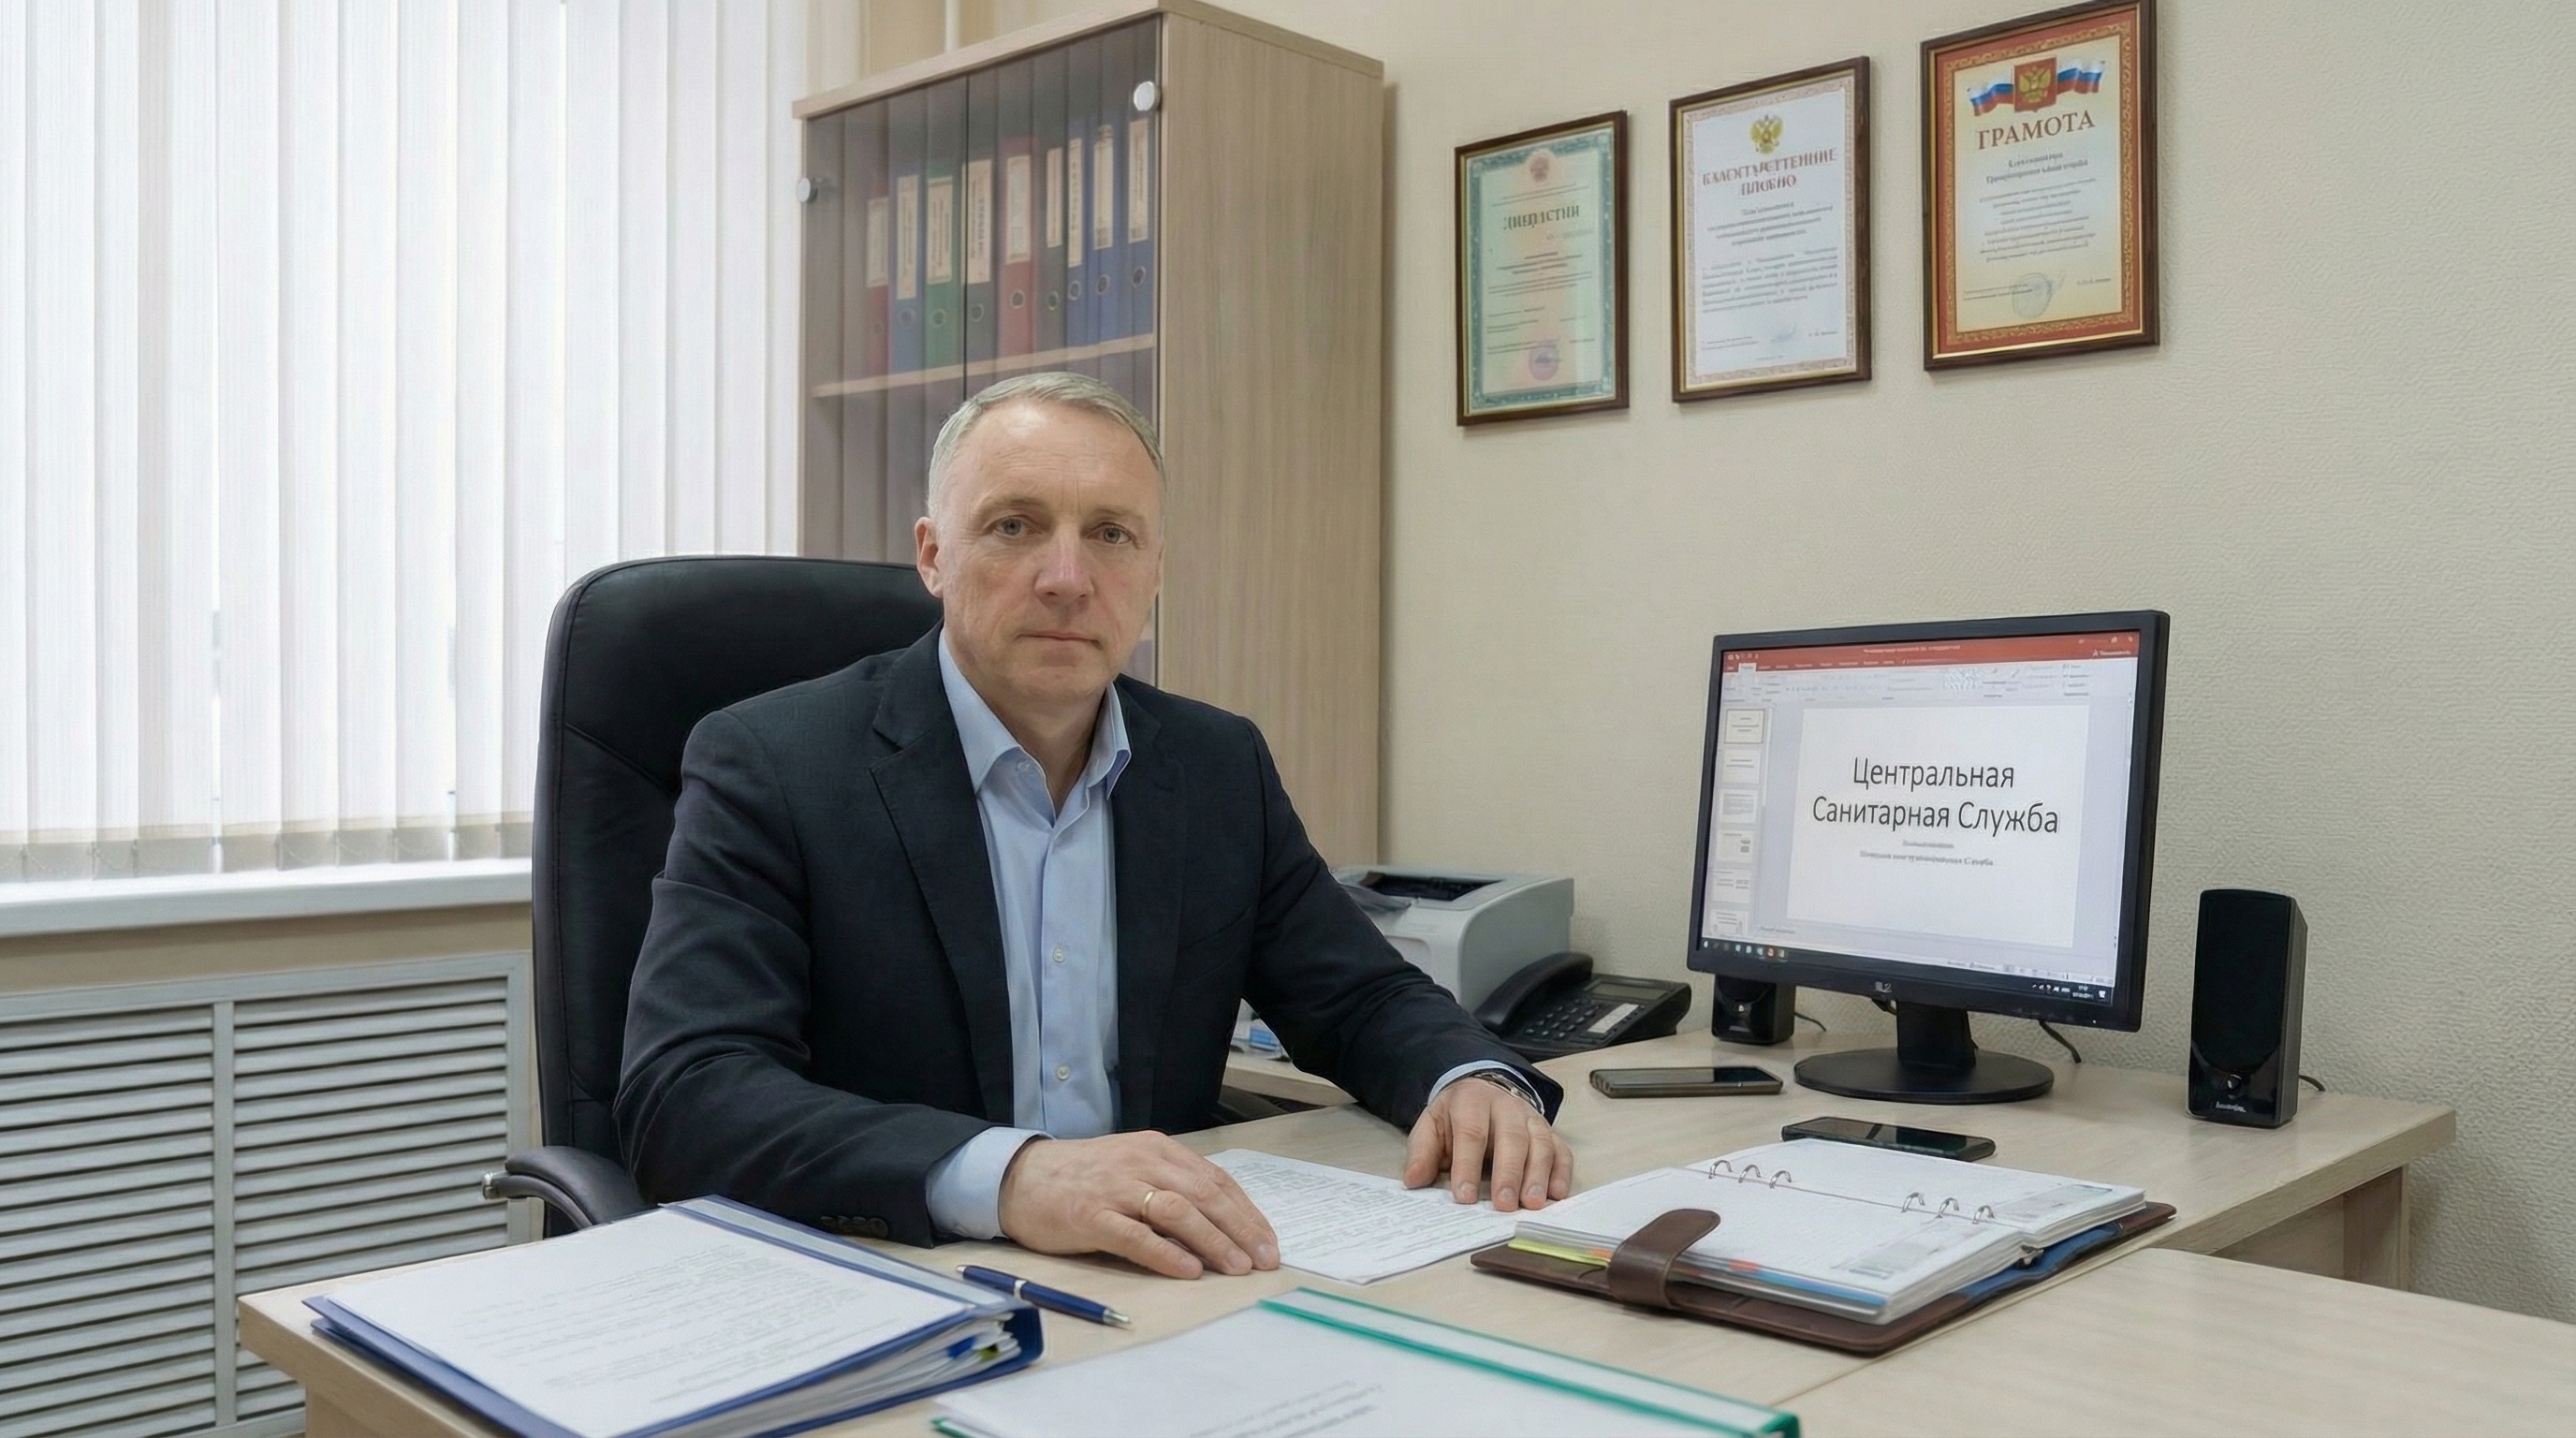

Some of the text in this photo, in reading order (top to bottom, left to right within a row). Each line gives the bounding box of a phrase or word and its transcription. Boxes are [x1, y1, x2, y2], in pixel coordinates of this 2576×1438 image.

[1977, 110, 2096, 150] ГРАМОТА
[1853, 756, 2014, 792] Центральная
[1812, 796, 2059, 838] Санитарная Служба
